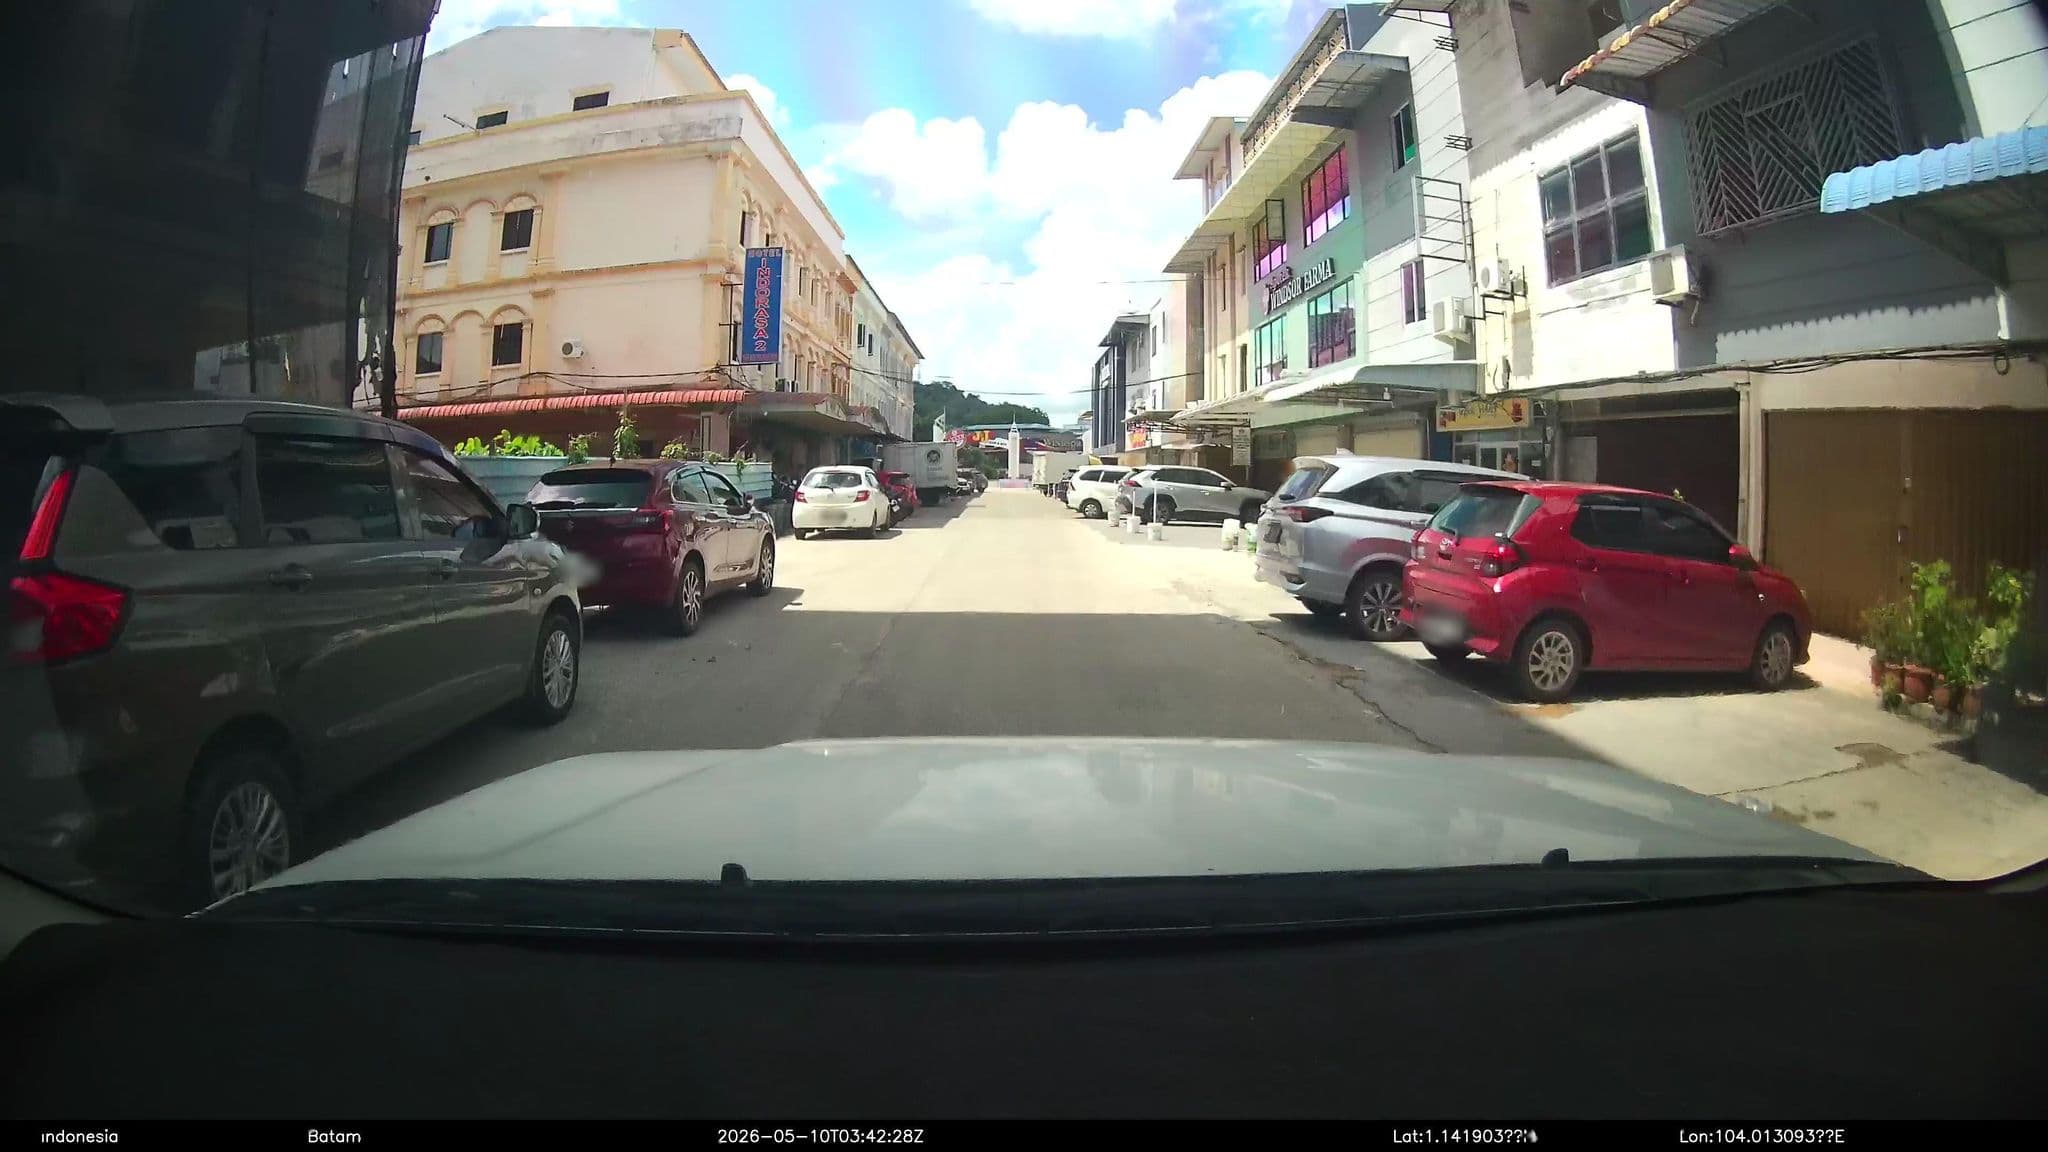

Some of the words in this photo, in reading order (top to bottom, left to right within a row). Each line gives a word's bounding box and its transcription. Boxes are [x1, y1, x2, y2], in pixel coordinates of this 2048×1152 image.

[753, 257, 771, 339] INDORASA
[1270, 276, 1303, 311] WINDSOR
[754, 340, 767, 352] 2
